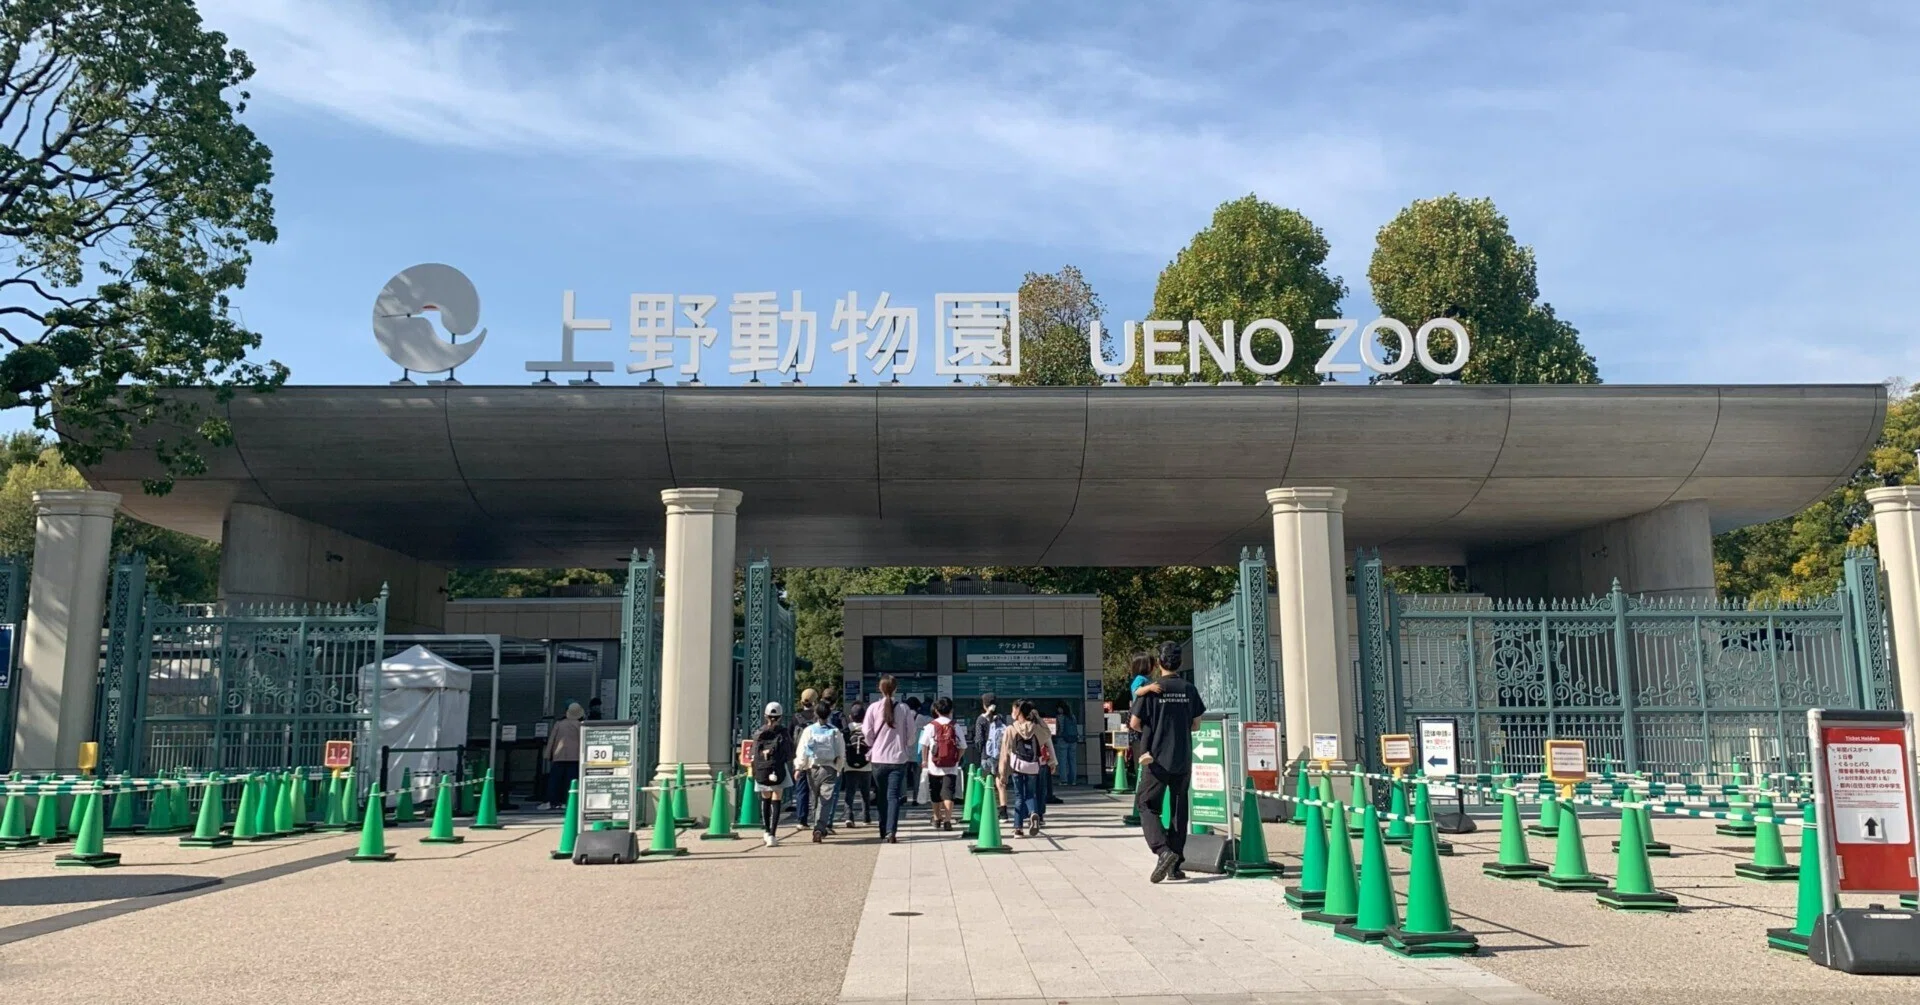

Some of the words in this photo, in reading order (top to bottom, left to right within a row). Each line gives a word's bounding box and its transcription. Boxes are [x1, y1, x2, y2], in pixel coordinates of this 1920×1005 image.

[525, 289, 1020, 376] 上野動物園
[1090, 317, 1295, 376] UENO
[1314, 317, 1471, 376] ZOO
[328, 748, 337, 759] 1
[340, 747, 348, 759] 2
[593, 750, 607, 759] 30
